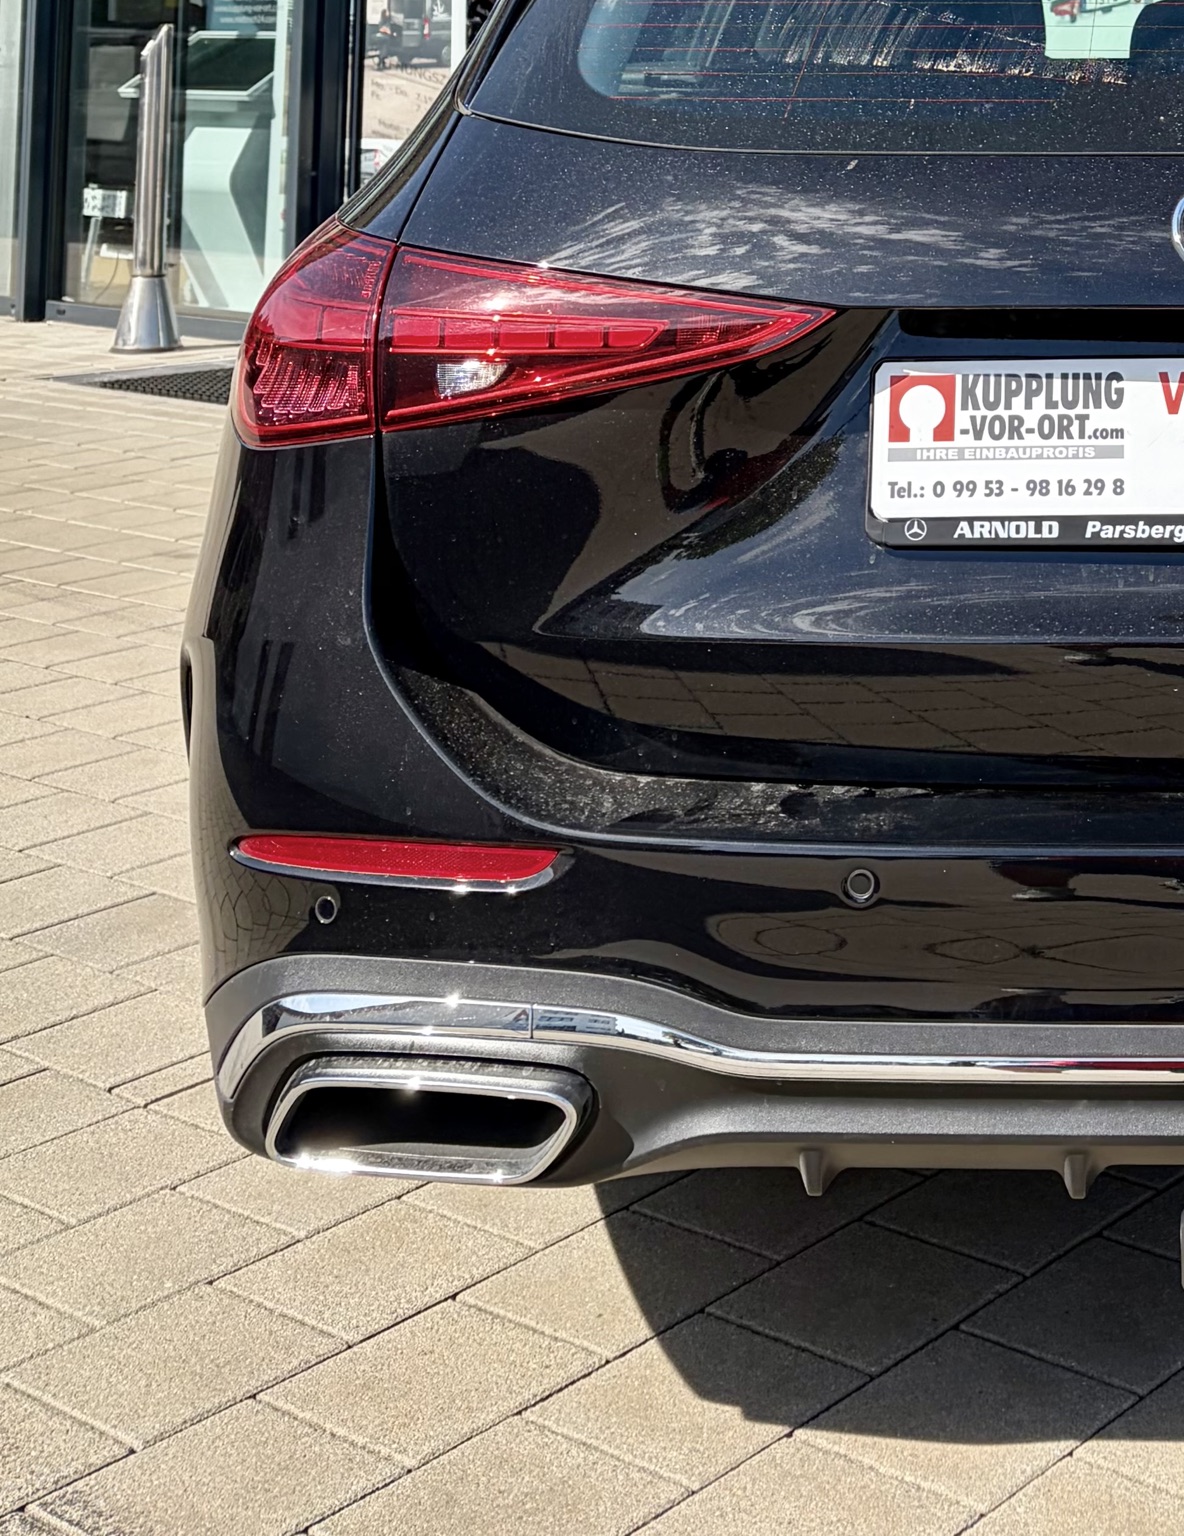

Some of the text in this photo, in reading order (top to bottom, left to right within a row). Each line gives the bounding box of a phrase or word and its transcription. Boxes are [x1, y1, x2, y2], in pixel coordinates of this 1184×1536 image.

[960, 372, 1125, 412] KUPPLUNG
[960, 414, 1125, 441] -VOR-ORT.com
[916, 446, 1096, 461] IHRE EINBAUPROFIS
[888, 481, 925, 499] Tel.:
[932, 481, 945, 498] 0
[953, 480, 977, 498] 99
[984, 480, 1004, 498] 53
[1026, 479, 1050, 497] 98
[1057, 479, 1076, 496] 16
[1083, 478, 1105, 496] 29
[953, 521, 1059, 539] ARNOLD
